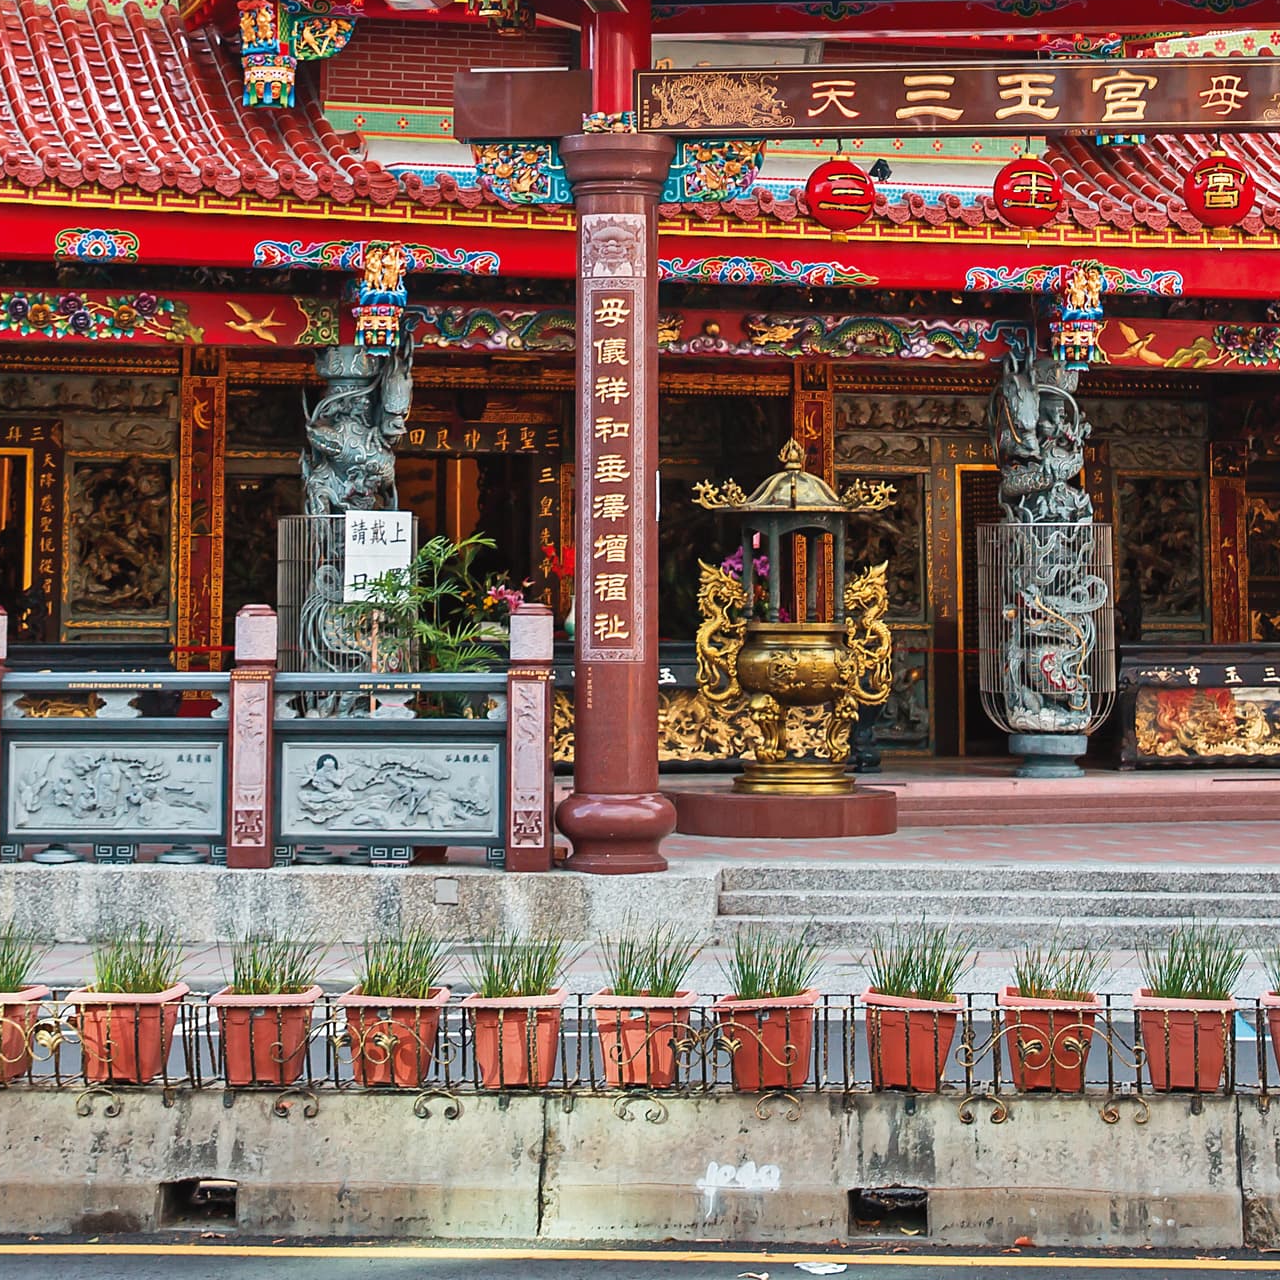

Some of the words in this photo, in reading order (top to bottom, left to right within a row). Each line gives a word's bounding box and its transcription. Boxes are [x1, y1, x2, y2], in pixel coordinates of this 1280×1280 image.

[818, 173, 873, 214] 三
[1196, 163, 1246, 209] 宮
[351, 520, 407, 546] 請戴上
